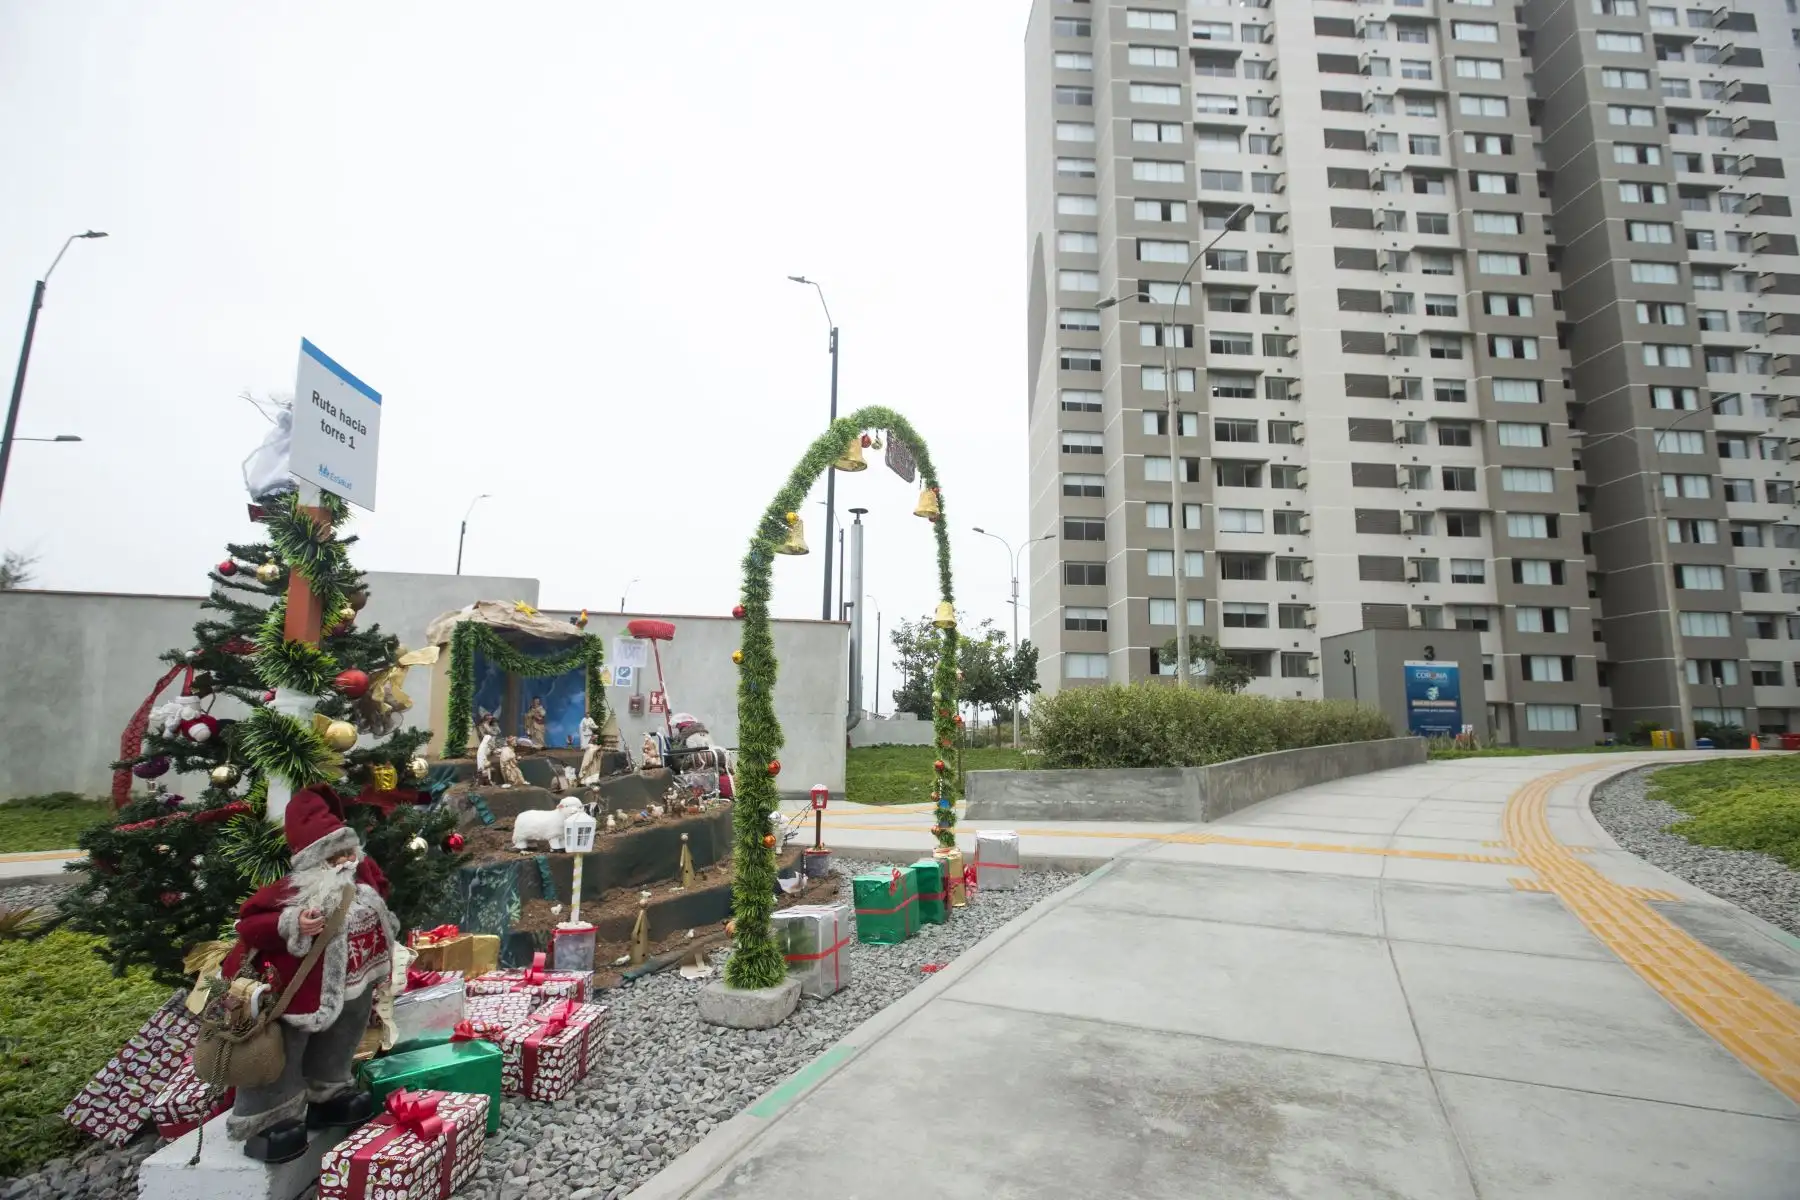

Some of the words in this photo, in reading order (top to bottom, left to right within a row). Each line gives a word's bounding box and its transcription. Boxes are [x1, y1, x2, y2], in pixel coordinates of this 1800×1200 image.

[312, 390, 337, 418] Ruta
[340, 408, 367, 435] hacia
[320, 418, 346, 443] torre
[348, 436, 355, 450] 1
[1343, 649, 1351, 664] 3
[1424, 645, 1436, 661] 3
